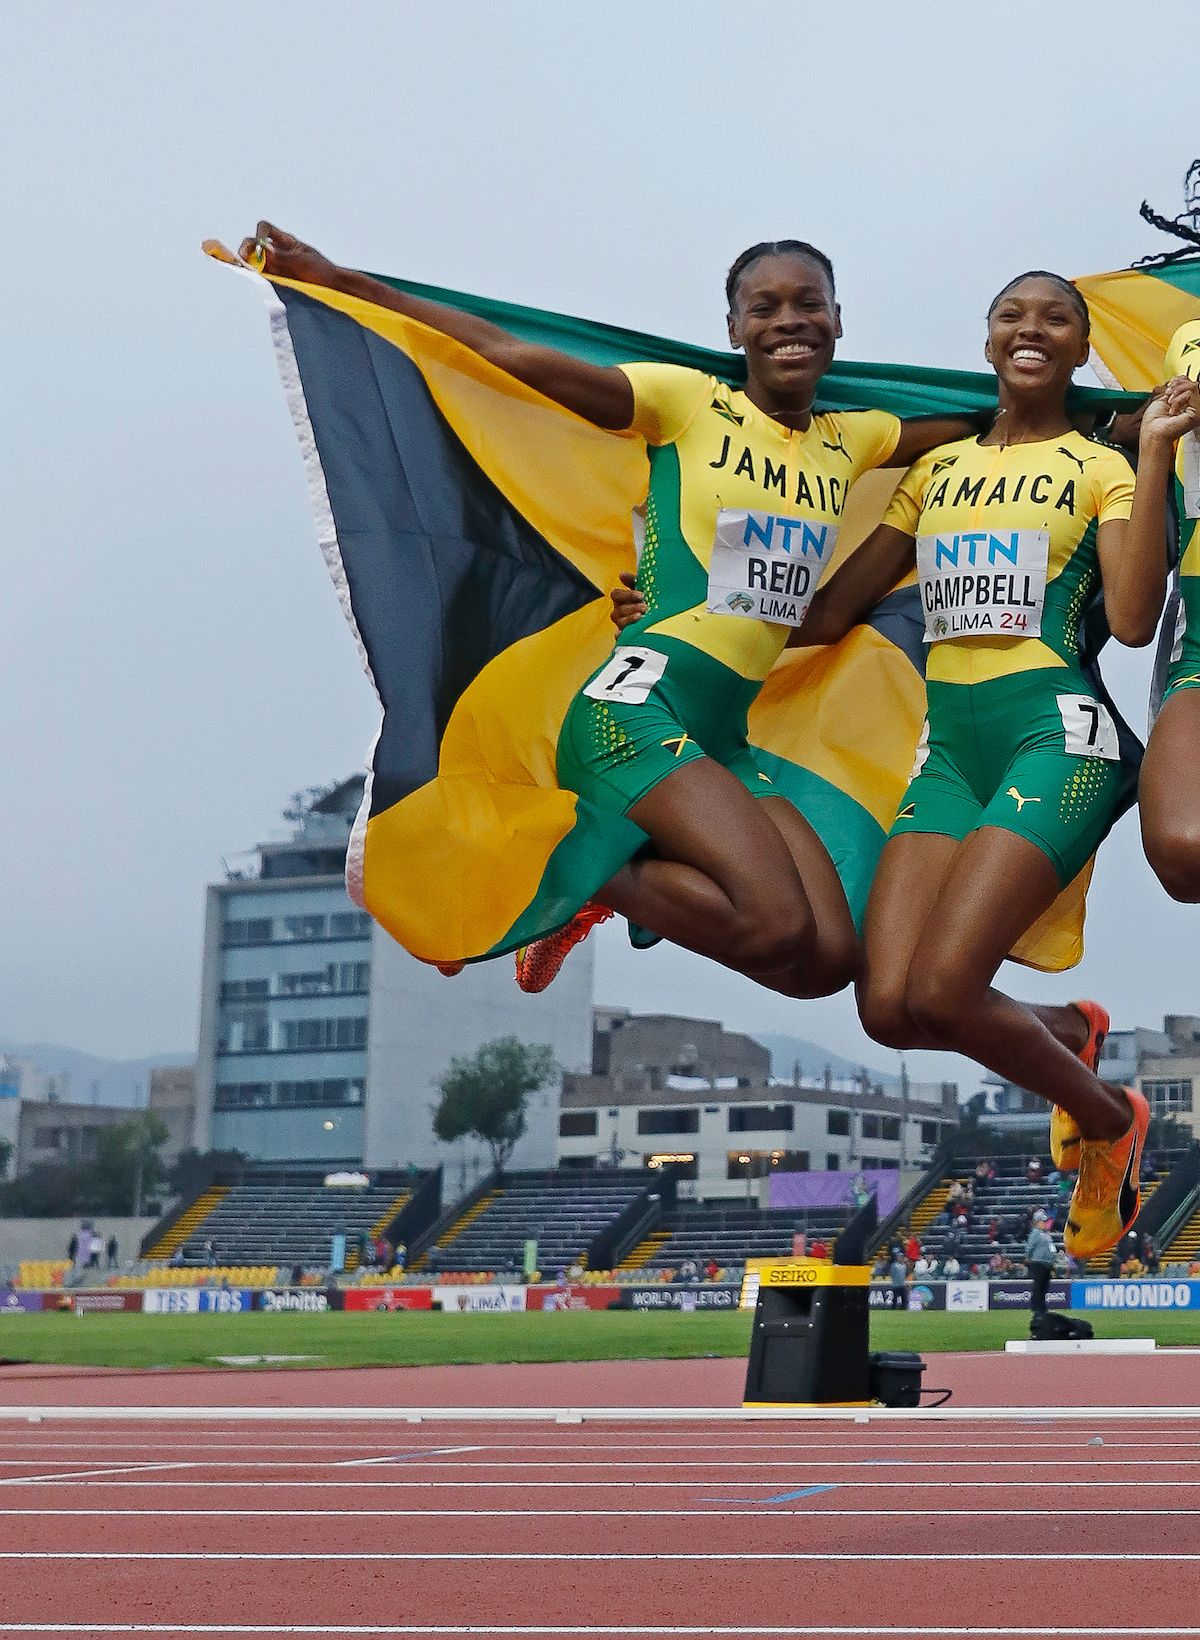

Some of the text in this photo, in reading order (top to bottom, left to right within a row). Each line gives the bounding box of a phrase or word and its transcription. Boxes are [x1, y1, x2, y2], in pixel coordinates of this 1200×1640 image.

[743, 512, 828, 560] NTN
[935, 532, 1020, 571] NTN
[748, 557, 811, 597] REID
[924, 574, 1037, 613] CAMPBELL
[759, 598, 797, 621] LIMA
[951, 612, 1028, 632] LIMA 24
[1077, 703, 1099, 746] 7
[770, 1269, 818, 1282] SEIKO
[157, 1291, 190, 1312] TBS
[207, 1290, 243, 1312] TBS
[1102, 1284, 1192, 1308] MONDO
